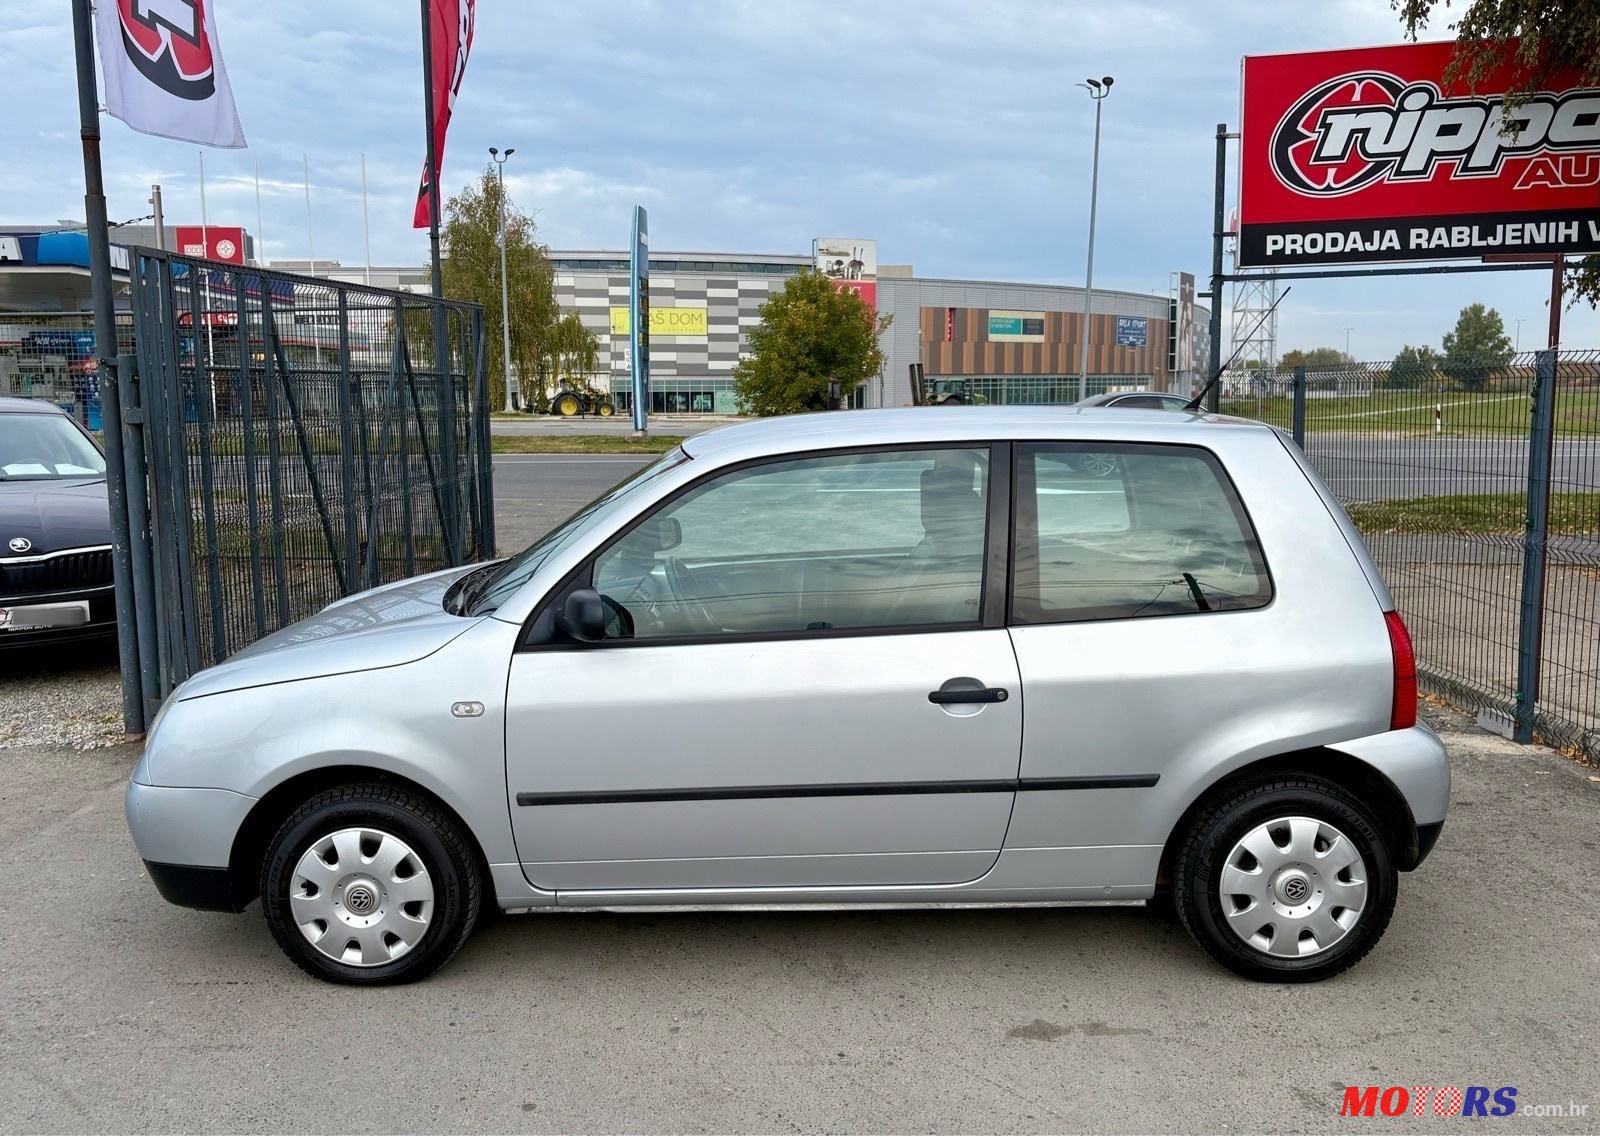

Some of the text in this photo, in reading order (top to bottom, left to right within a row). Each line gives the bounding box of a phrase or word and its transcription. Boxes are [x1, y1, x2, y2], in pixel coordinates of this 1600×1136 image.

[1266, 227, 1400, 256] PRODAJA
[1409, 221, 1579, 250] RABLJENIH
[669, 312, 703, 326] DOM
